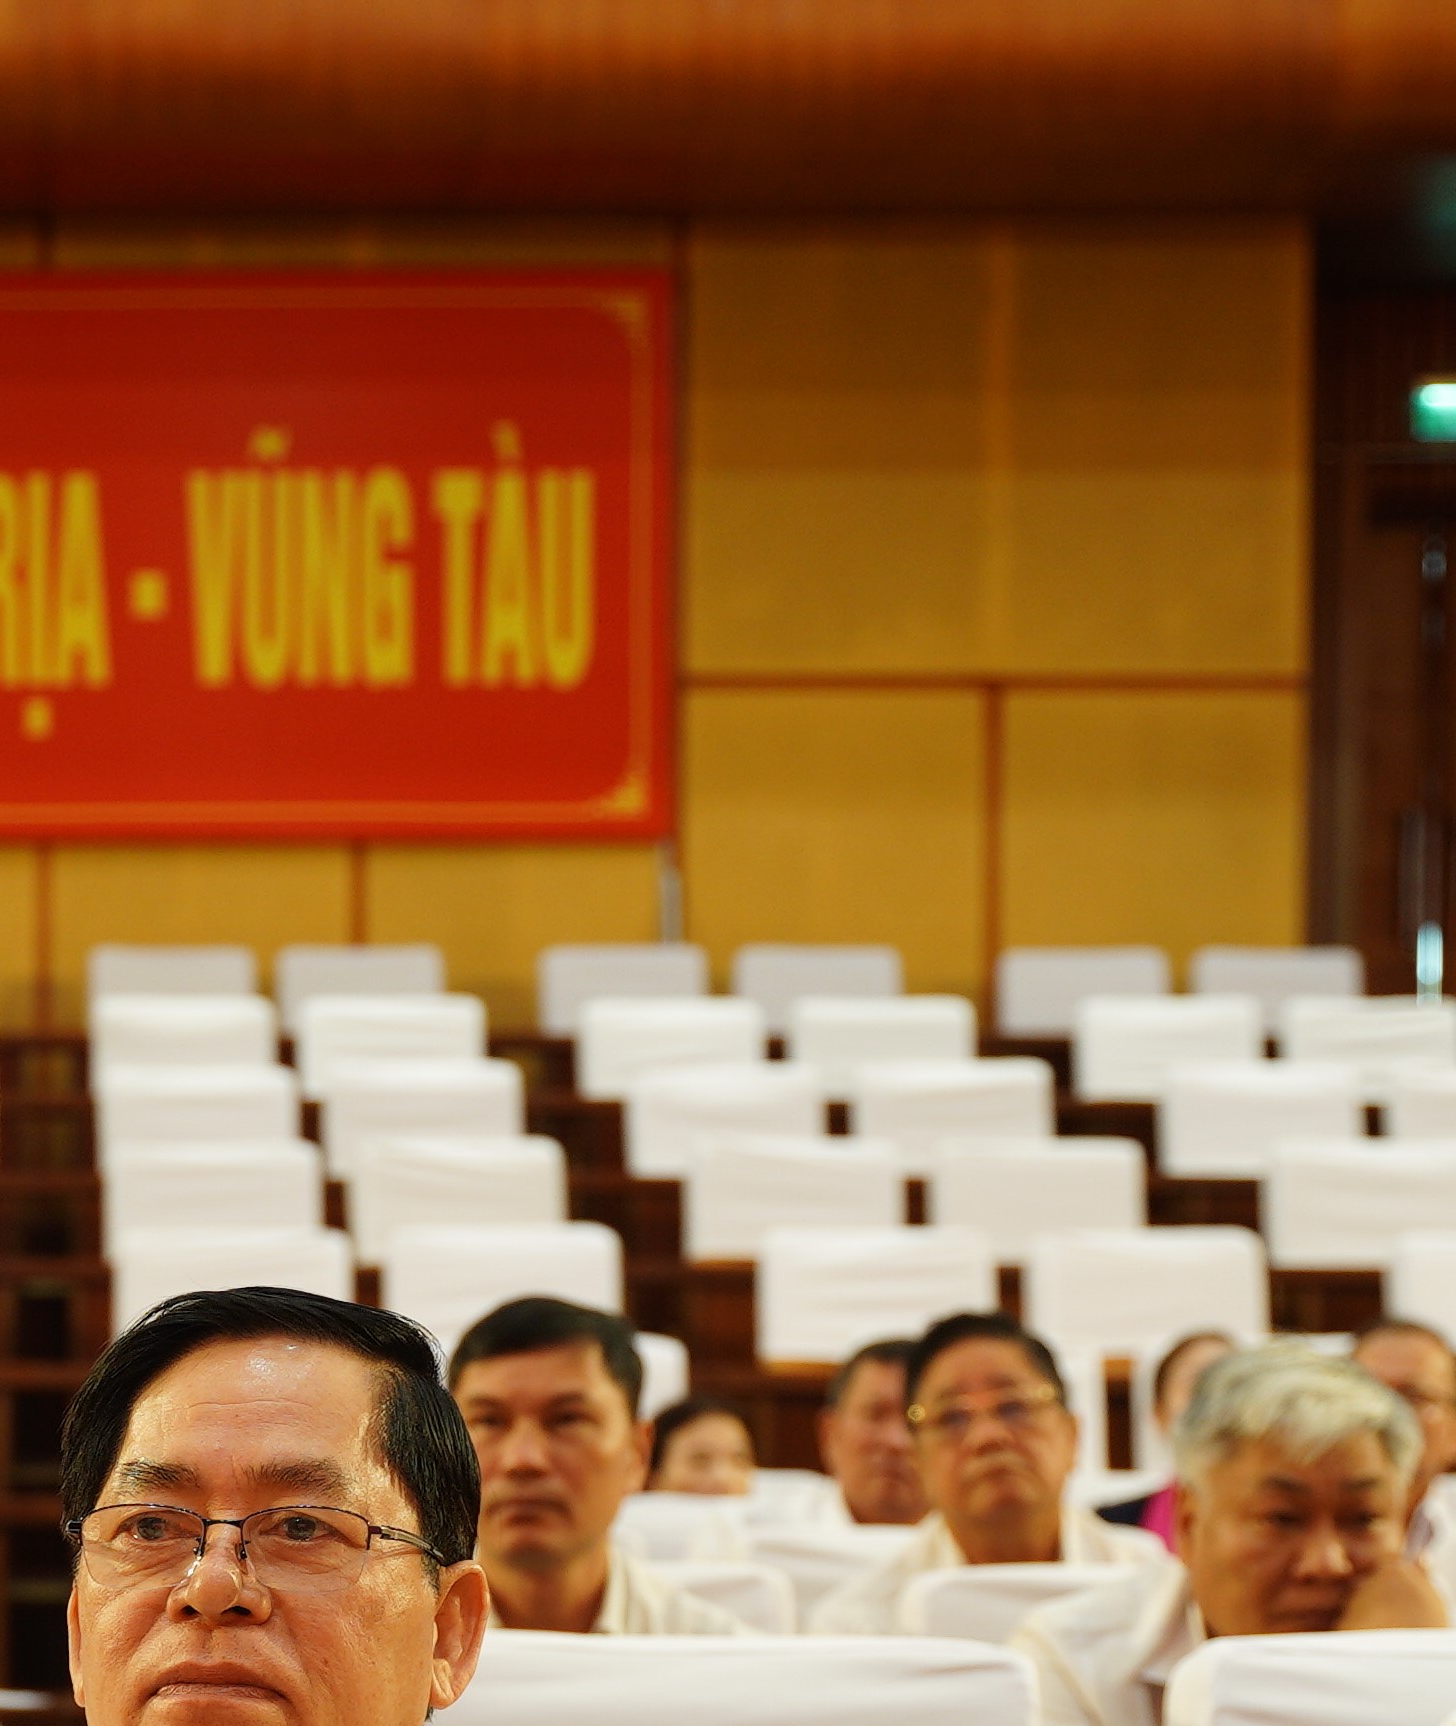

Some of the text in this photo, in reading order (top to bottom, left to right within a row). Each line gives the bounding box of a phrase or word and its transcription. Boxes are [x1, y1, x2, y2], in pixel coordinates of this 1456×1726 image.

[127, 568, 169, 621] -
[183, 425, 416, 690] VŨNG
[429, 420, 596, 690] TÀU
